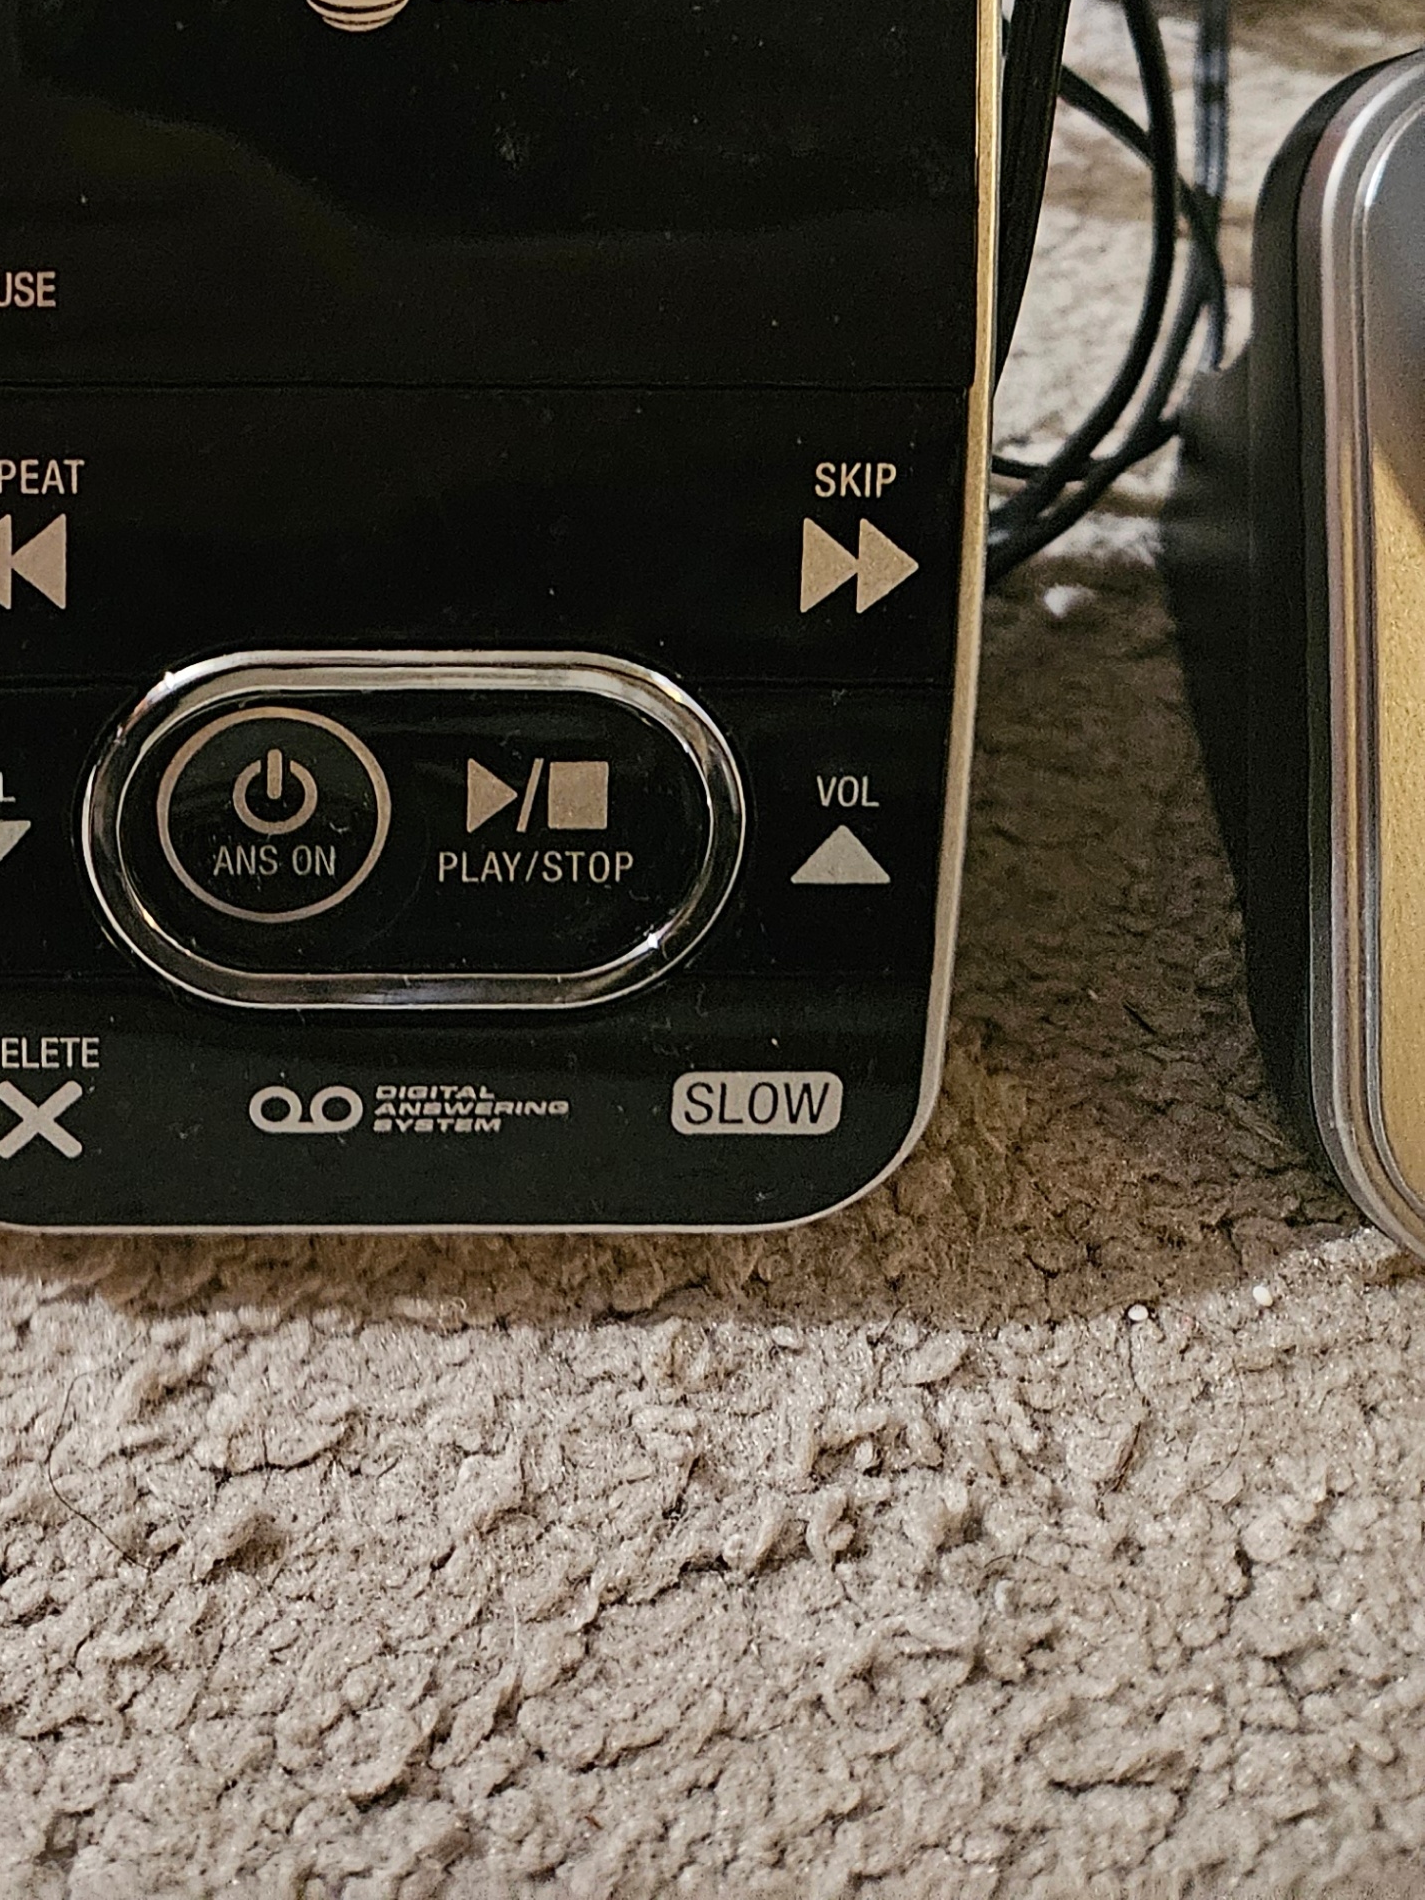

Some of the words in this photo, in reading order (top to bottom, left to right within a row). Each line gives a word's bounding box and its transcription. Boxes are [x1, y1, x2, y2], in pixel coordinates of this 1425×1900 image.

[814, 462, 897, 498] SKIP
[816, 775, 880, 807] VOL
[213, 844, 278, 876] ANS
[292, 845, 336, 876] ON
[438, 850, 634, 883] PLAY/STOP
[374, 1101, 569, 1116] ANSWERING
[375, 1085, 495, 1100] DIGITAL
[684, 1081, 830, 1126] SLOW
[373, 1117, 502, 1133] SYSTEM
